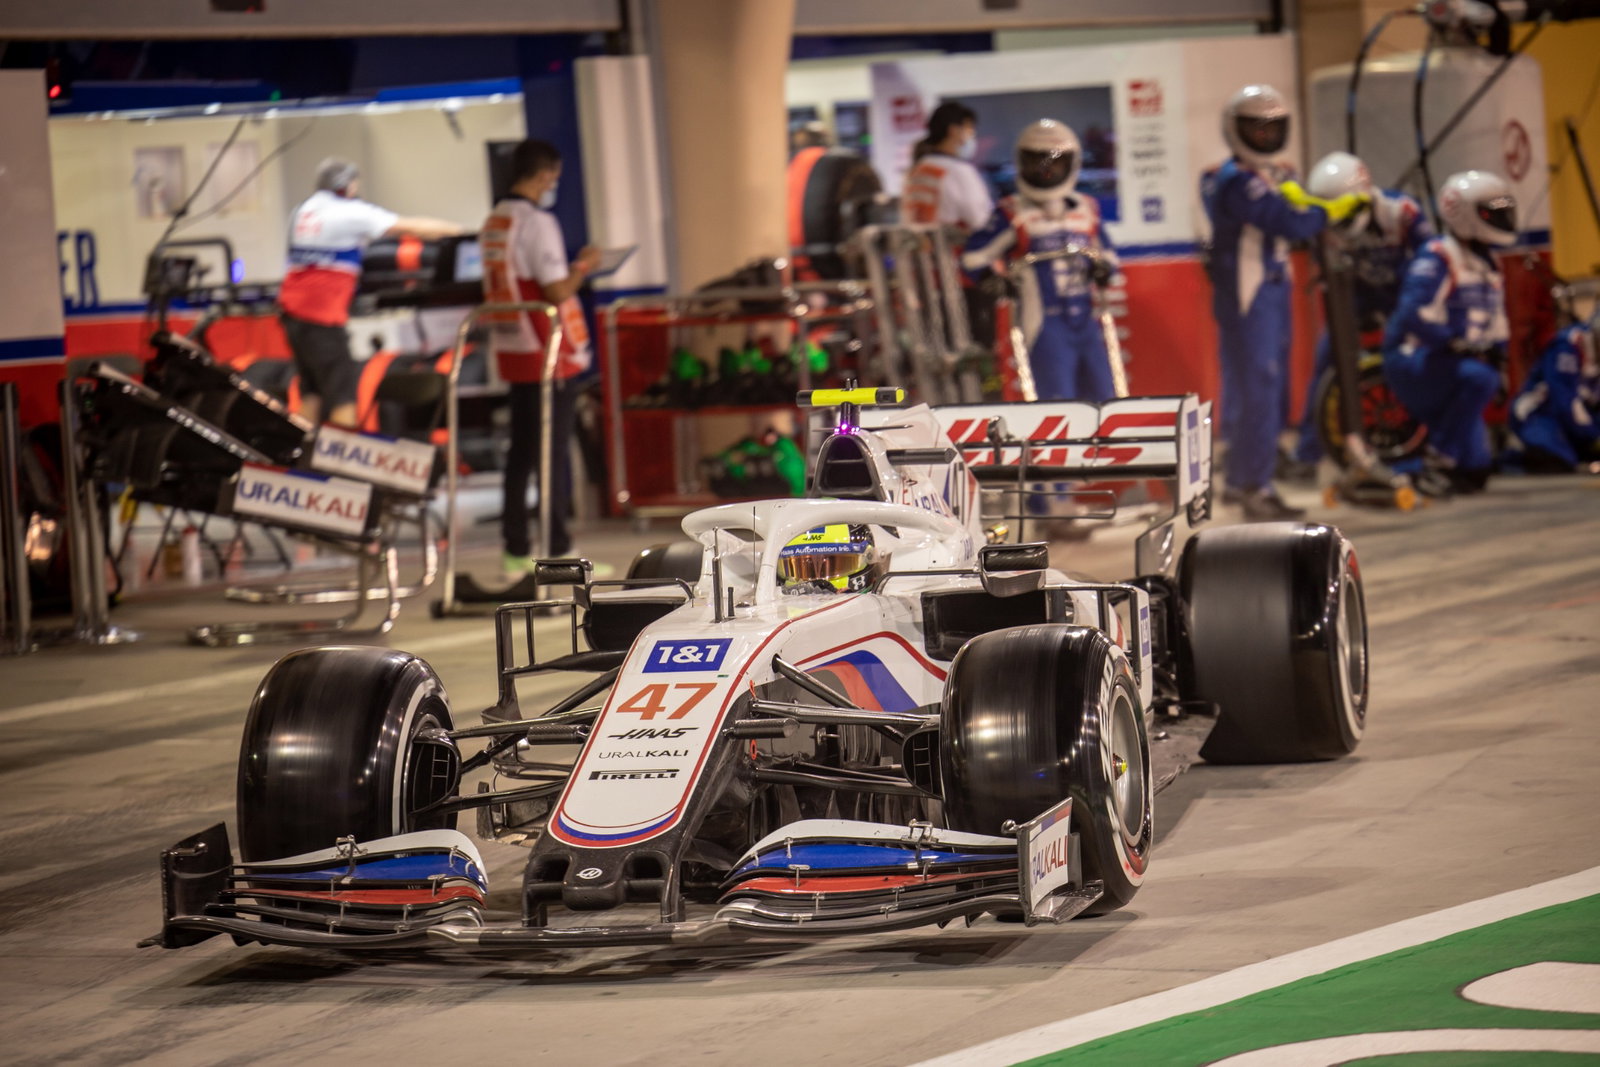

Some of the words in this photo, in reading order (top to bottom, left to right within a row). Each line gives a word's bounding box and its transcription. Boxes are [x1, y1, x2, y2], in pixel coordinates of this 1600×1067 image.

[316, 437, 430, 480] URALKALI
[238, 479, 367, 521] URALKALI
[795, 546, 837, 554] Automation
[658, 645, 721, 664] 1&1
[616, 683, 718, 720] 47
[608, 727, 700, 740] HAAS
[598, 749, 689, 759] URALKALI
[588, 768, 680, 781] PIRELLI
